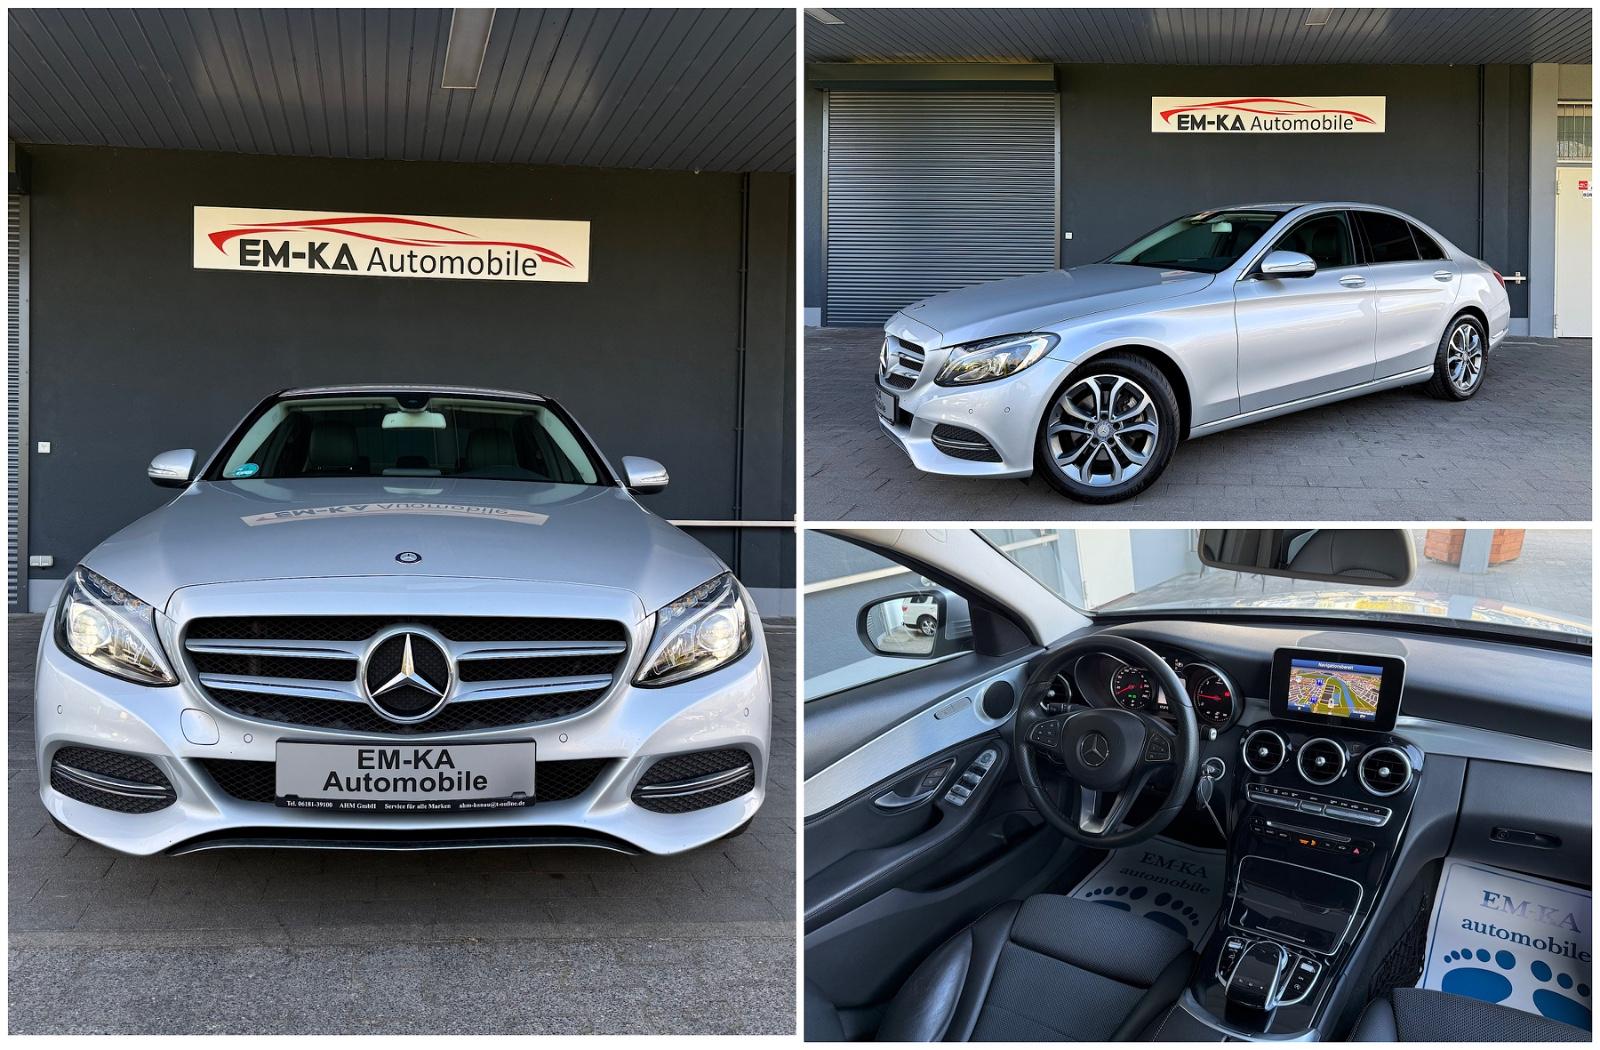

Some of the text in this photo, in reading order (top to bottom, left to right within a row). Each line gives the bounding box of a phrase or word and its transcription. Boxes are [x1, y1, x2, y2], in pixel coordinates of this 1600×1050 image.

[1177, 114, 1354, 131] EM-KA Automobile
[239, 238, 537, 277] EM-KA Automobile
[357, 749, 456, 770] EM-KA
[322, 771, 488, 793] Automobile
[1140, 852, 1208, 878] EM-KA
[1119, 867, 1210, 895] automobile
[1480, 890, 1582, 933] EM-KA
[1461, 918, 1592, 963] automobile
